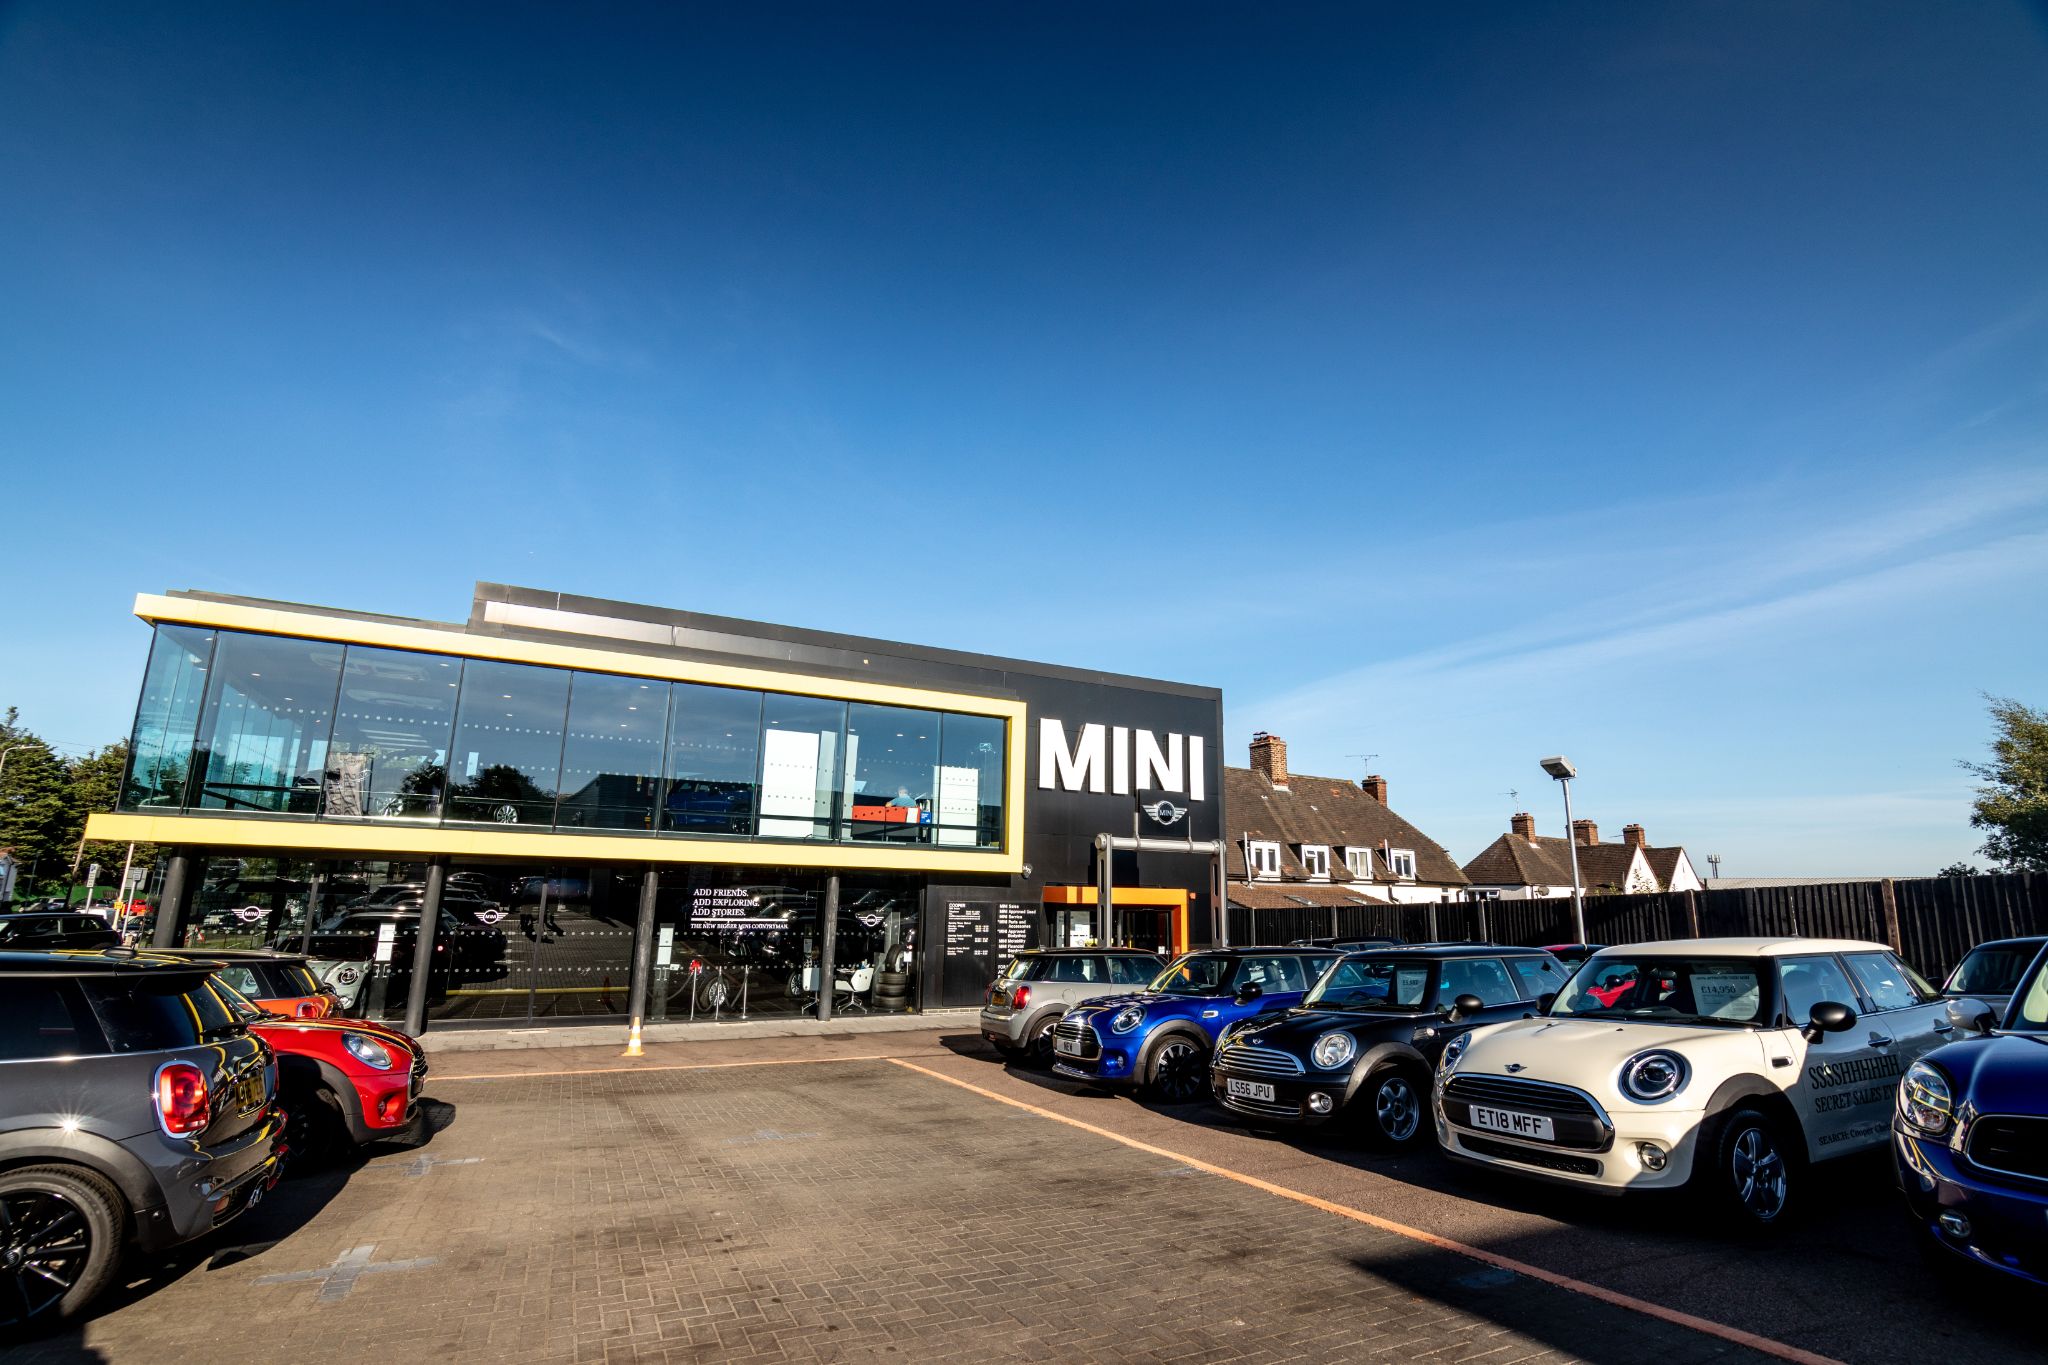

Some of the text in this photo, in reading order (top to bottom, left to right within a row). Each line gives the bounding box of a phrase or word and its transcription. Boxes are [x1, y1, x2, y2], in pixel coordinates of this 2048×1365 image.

[1038, 717, 1204, 801] MINI
[693, 888, 749, 897] ADD FRIENDS.
[692, 898, 760, 907] ADD EXPLORING.
[692, 908, 746, 916] ADD STORIES.
[1063, 1041, 1073, 1052] NEW
[1230, 1081, 1270, 1099] LS56 JPU
[1815, 1092, 1851, 1114] SECRET
[1853, 1086, 1883, 1106] SALES
[1477, 1108, 1542, 1134] ET18 MFF
[1819, 1131, 1849, 1146] SEARCH:
[1849, 1126, 1874, 1139] Cooper
